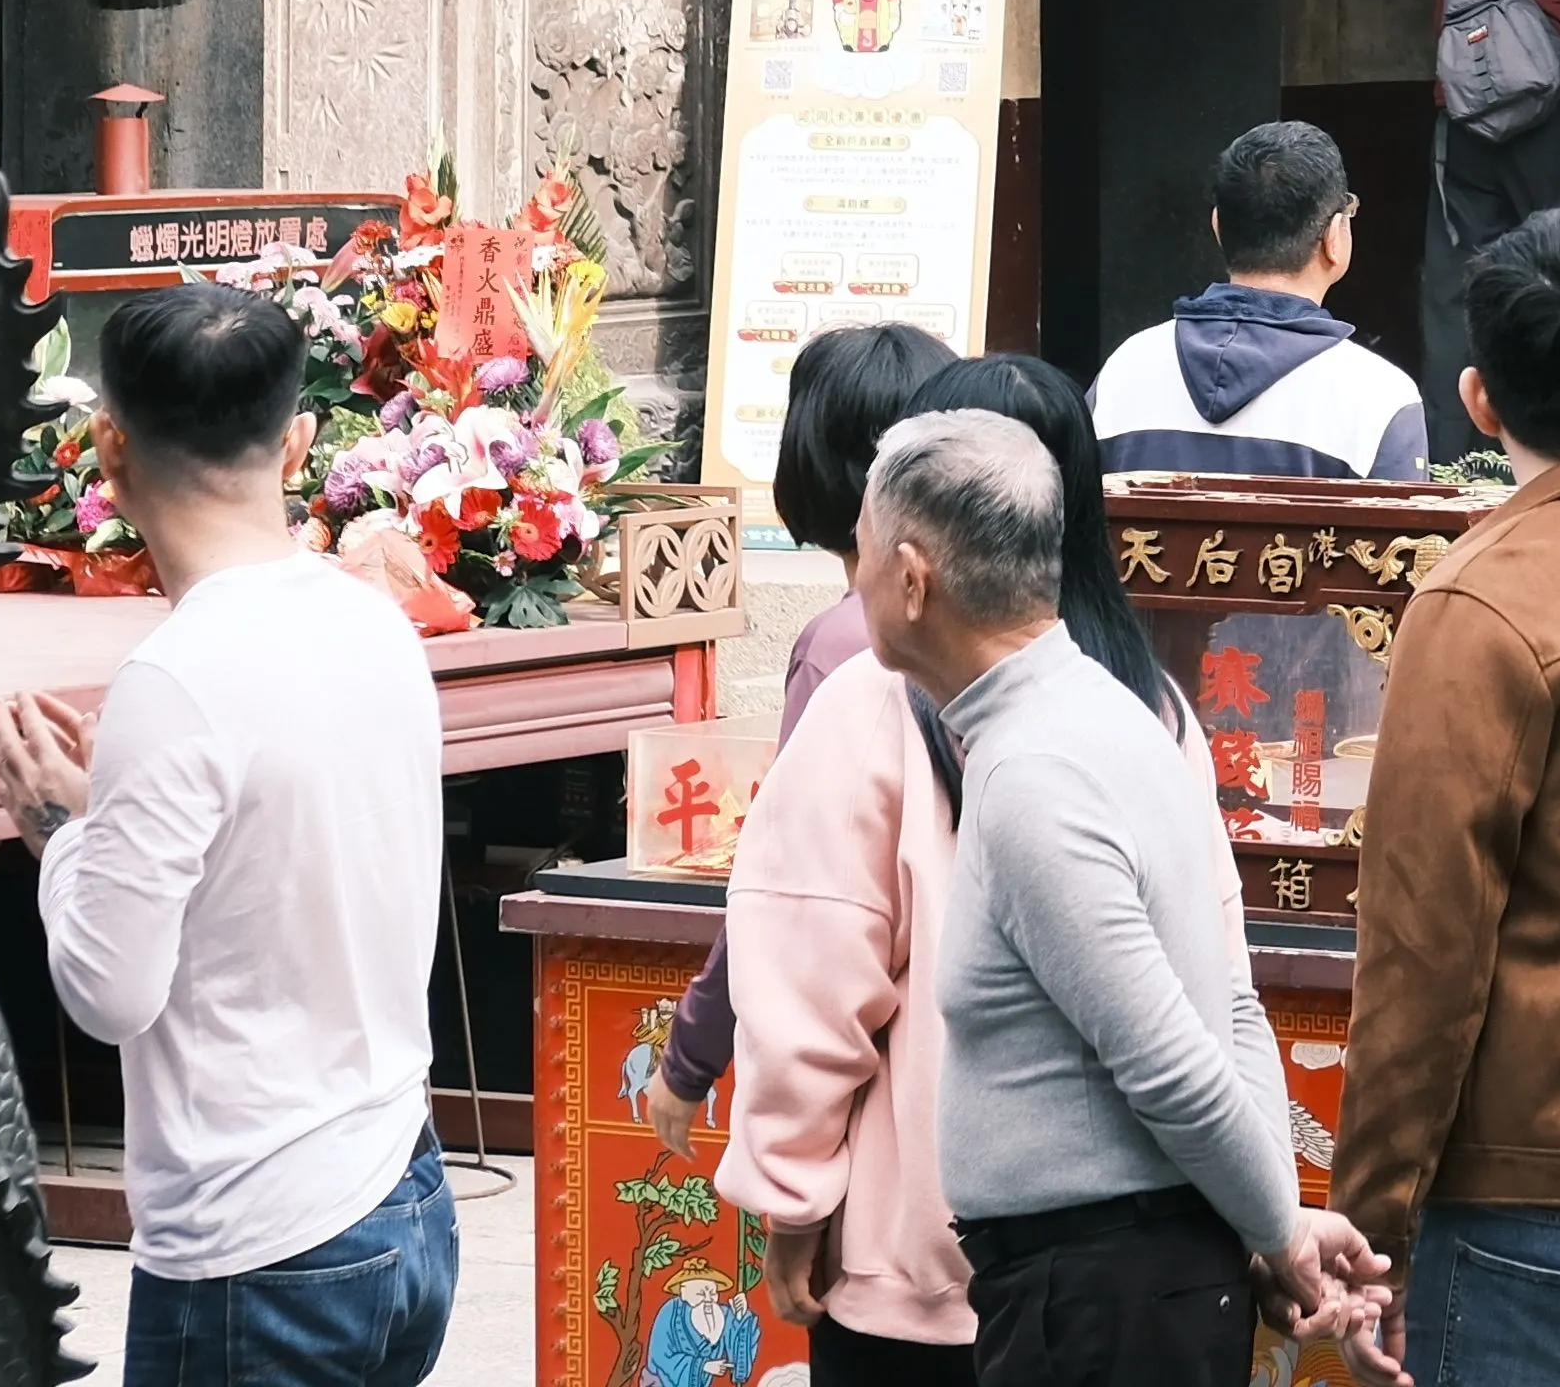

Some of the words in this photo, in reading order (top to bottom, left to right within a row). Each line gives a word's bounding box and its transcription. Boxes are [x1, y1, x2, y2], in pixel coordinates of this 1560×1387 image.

[129, 216, 329, 263] 蠟燭光明燈放置處
[472, 235, 503, 356] 香火鼎盛
[1120, 527, 1304, 594] 天后宮
[1290, 689, 1326, 833] 媽祖賜福
[1268, 858, 1314, 910] 箱
